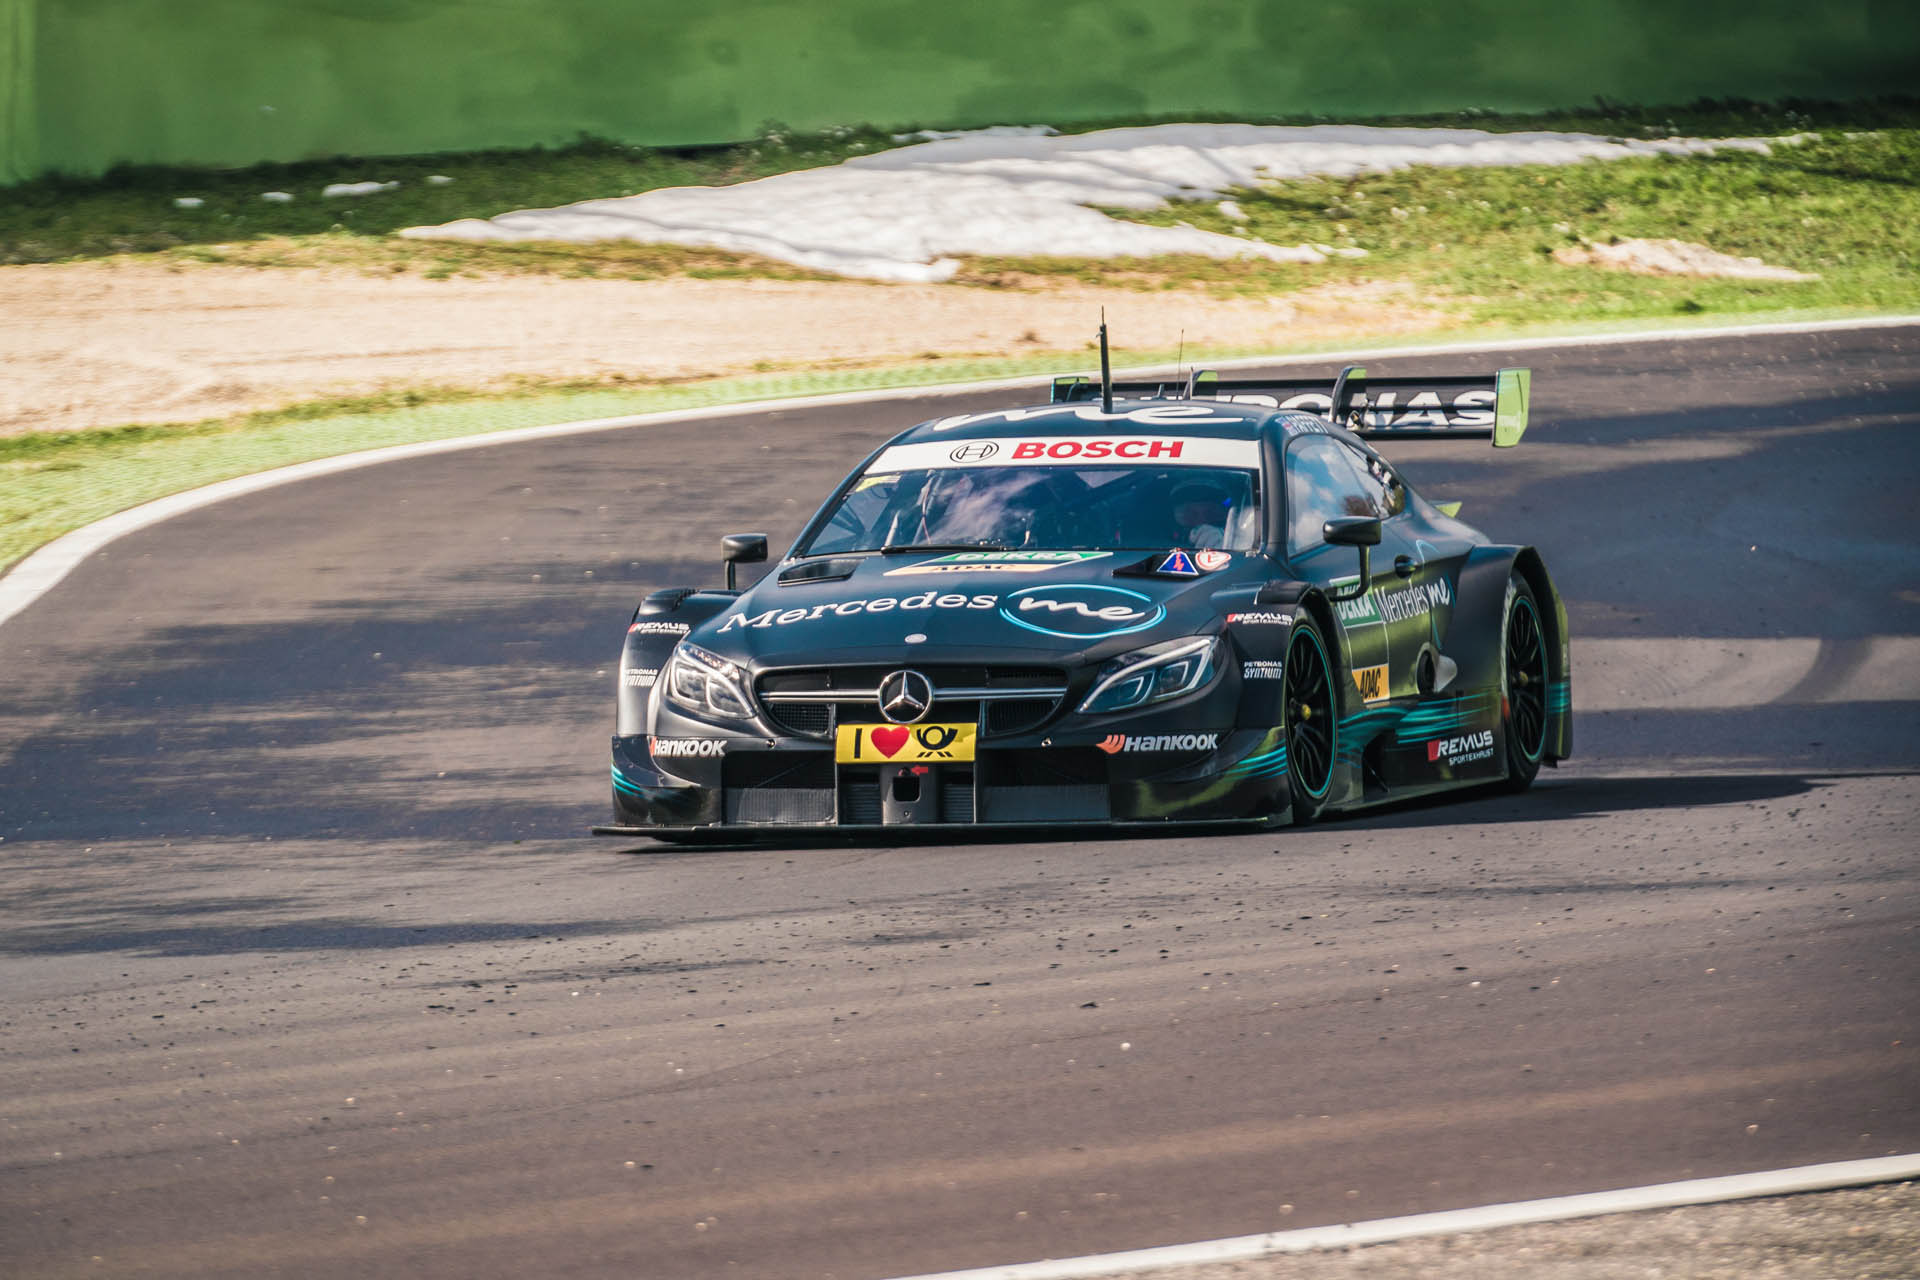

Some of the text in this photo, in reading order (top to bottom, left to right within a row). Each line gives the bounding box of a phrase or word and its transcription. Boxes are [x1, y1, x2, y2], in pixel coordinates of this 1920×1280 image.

[933, 406, 1244, 431] me
[1011, 441, 1184, 459] BOSCH
[717, 591, 1146, 632] Mercedes me
[1374, 577, 1450, 622] Mercedes me
[634, 622, 690, 632] REMUS
[1231, 612, 1293, 622] REMUS
[1360, 668, 1381, 699] ADAC
[854, 728, 862, 759] I
[1437, 730, 1494, 757] REMUS
